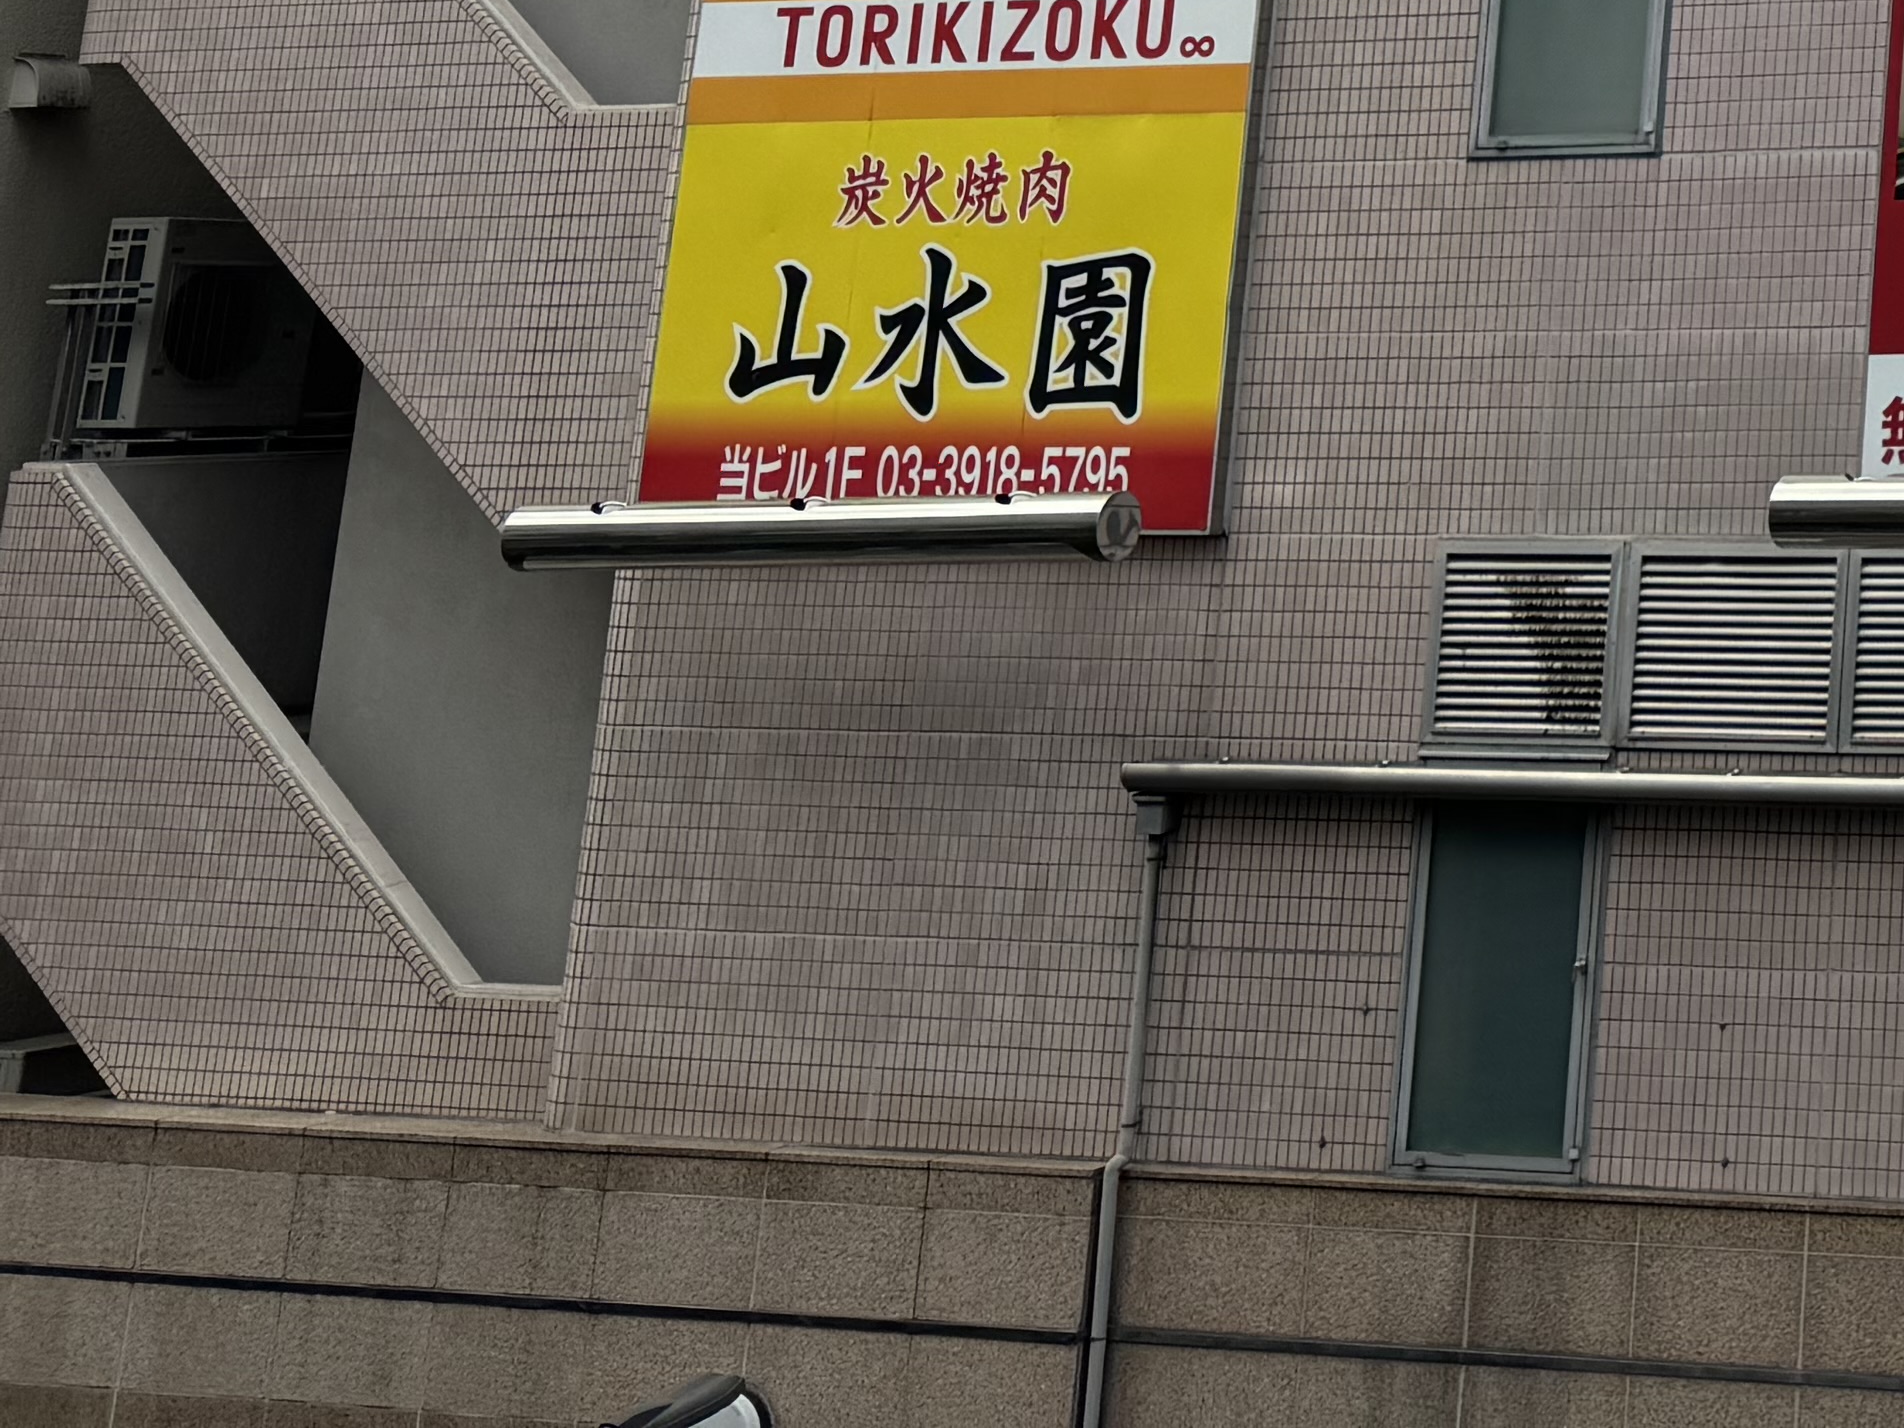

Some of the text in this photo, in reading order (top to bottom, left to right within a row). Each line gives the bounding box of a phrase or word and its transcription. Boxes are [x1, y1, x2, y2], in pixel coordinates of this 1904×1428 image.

[834, 150, 1070, 228] 炭火焼肉
[725, 244, 1156, 424] 山水園
[876, 445, 1130, 497] 03-3918-5795
